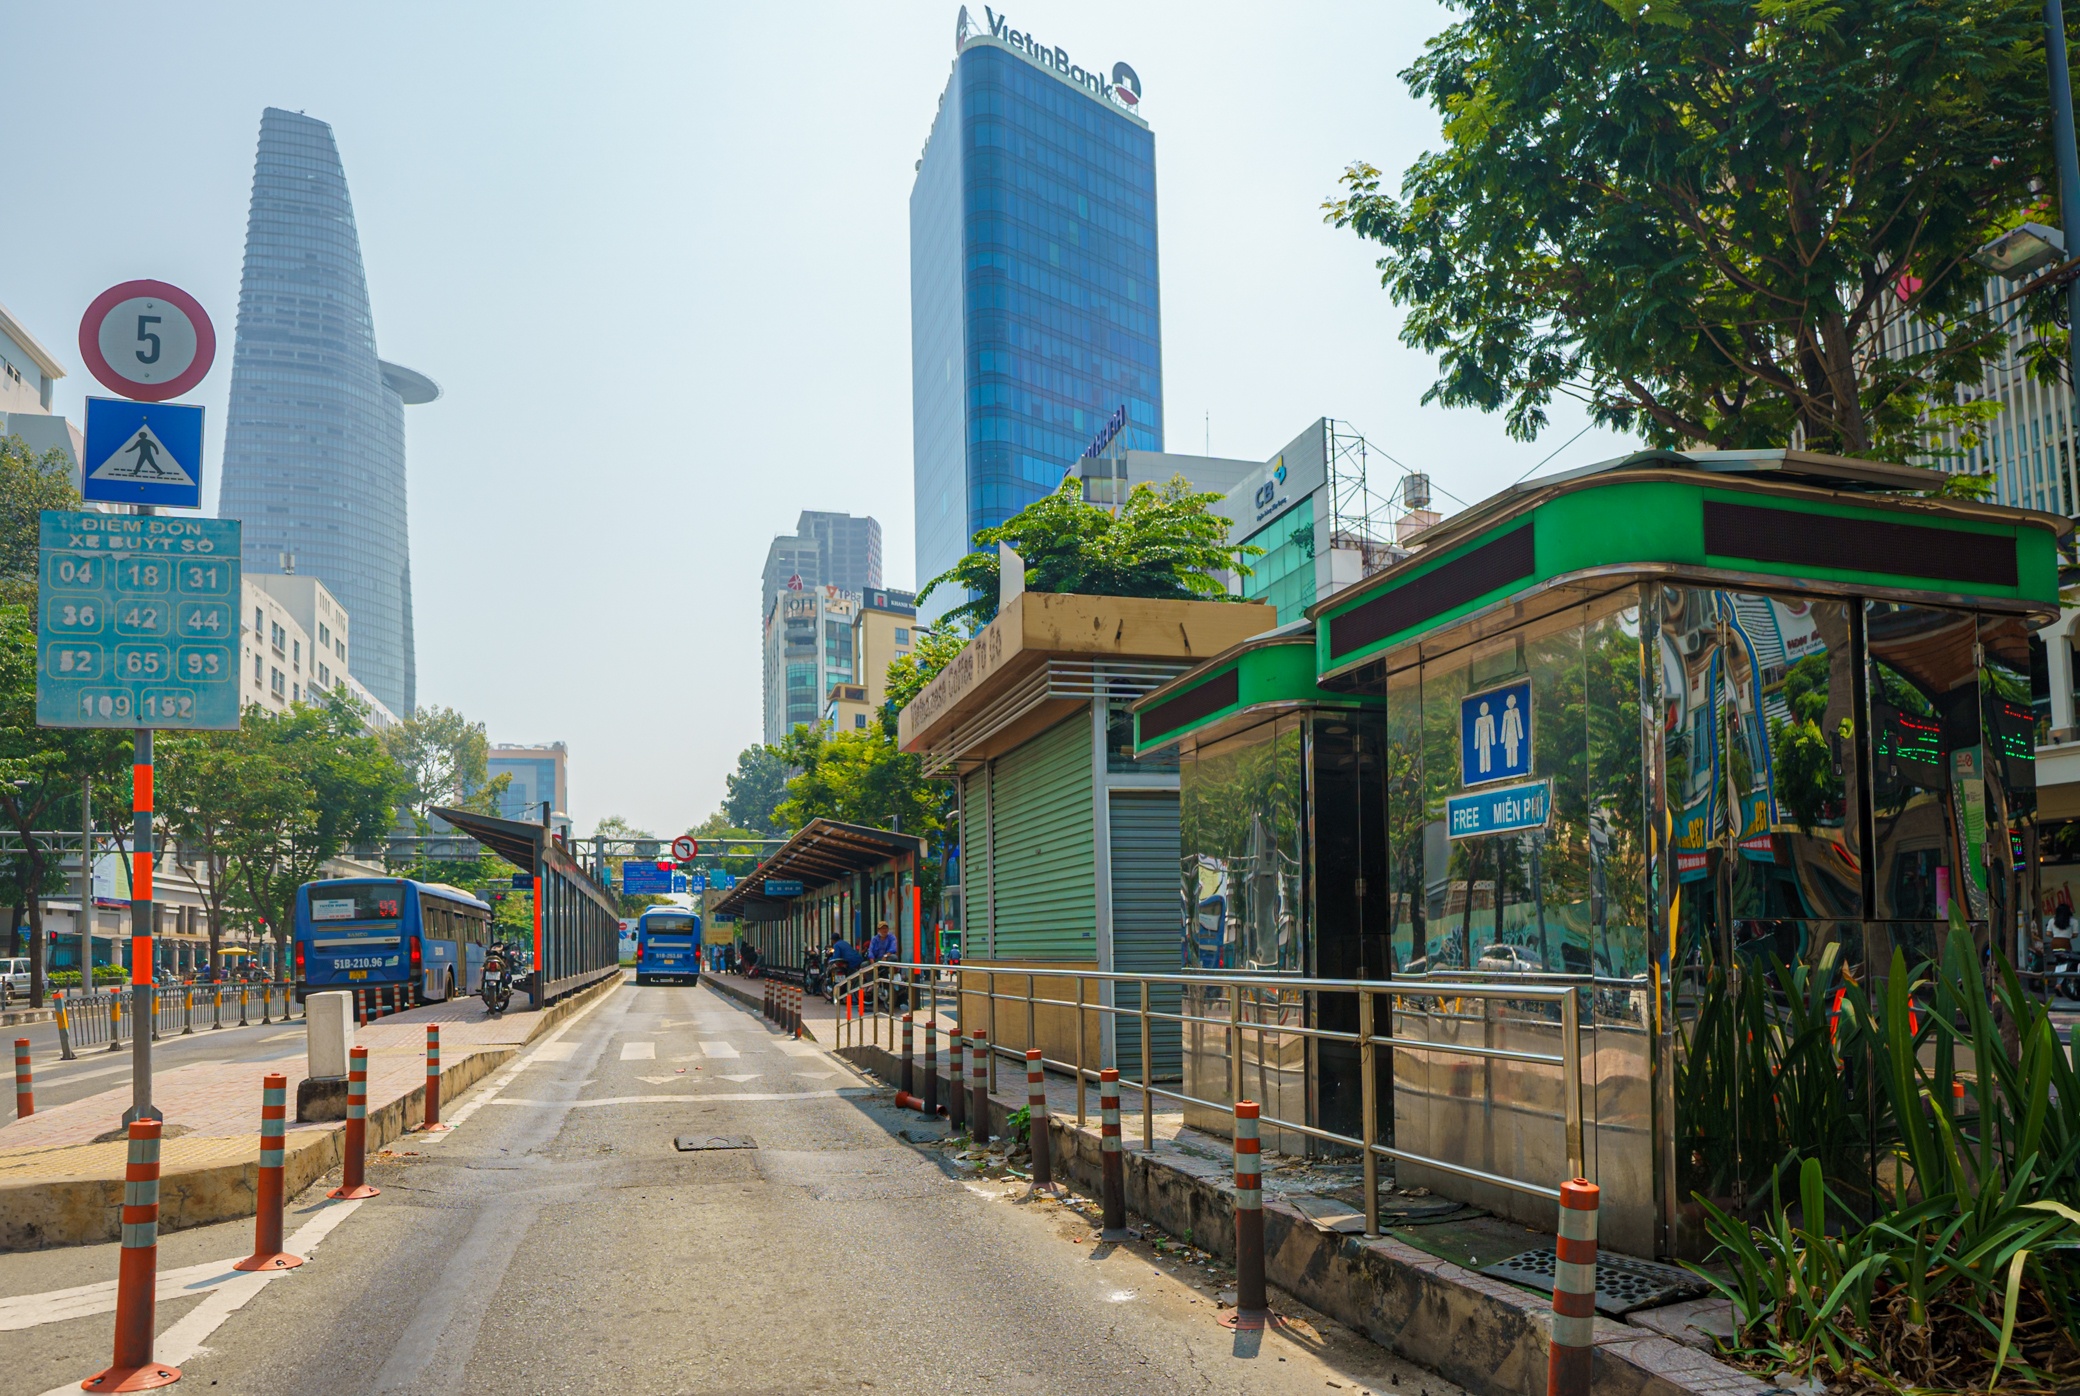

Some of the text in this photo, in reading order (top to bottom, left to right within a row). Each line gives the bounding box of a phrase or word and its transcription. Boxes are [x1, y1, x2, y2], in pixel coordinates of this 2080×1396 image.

[984, 5, 1115, 101] VietinBank
[135, 315, 162, 365] 5
[1254, 480, 1275, 509] CB
[59, 561, 217, 589] 04 18 31
[62, 605, 220, 632] 36 42 44
[126, 651, 160, 674] 65
[187, 653, 219, 674] 93
[81, 695, 193, 720] 109 152
[1453, 806, 1480, 830] FREE
[1493, 796, 1521, 825] MIỄN
[379, 899, 398, 917] 93
[333, 957, 383, 969] 51B-210.96
